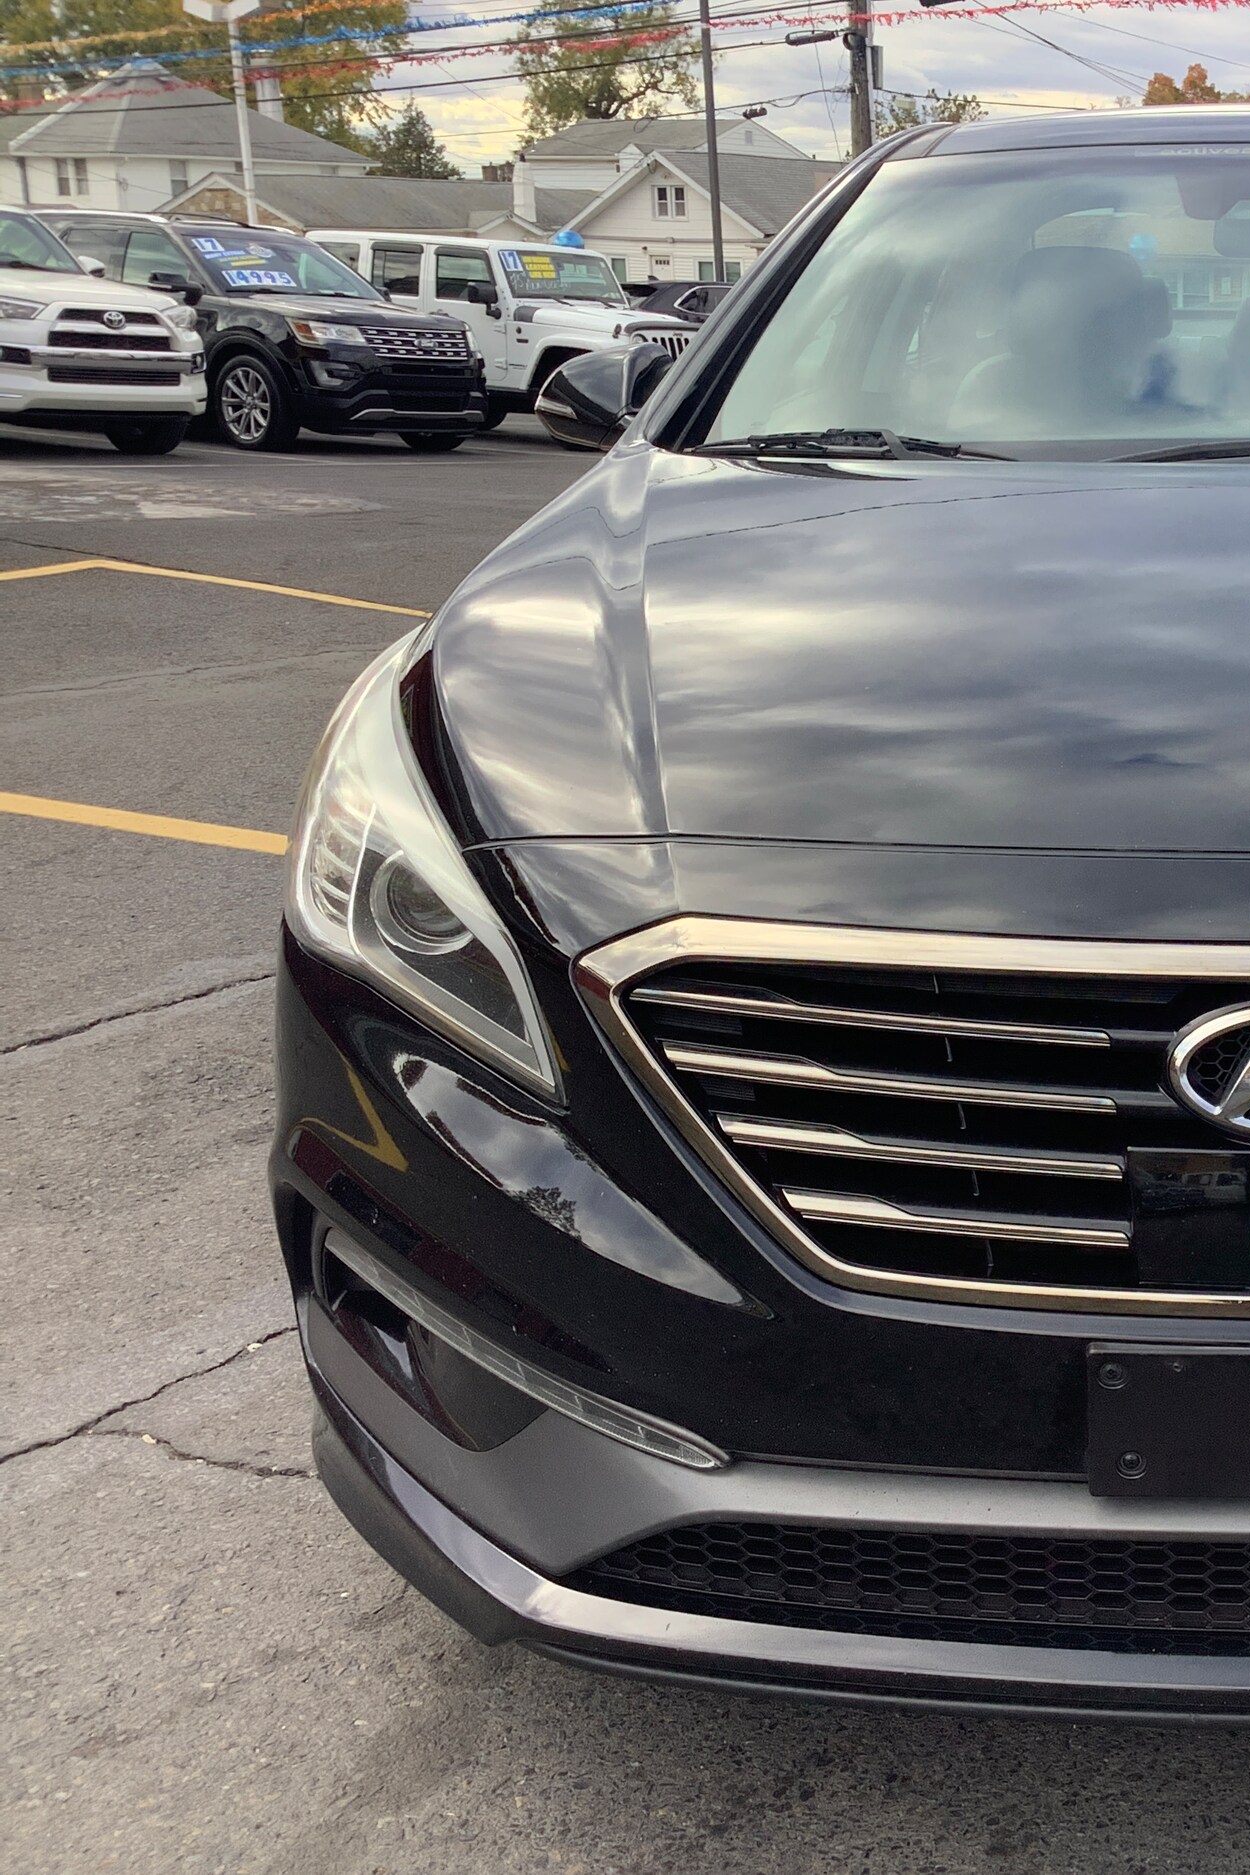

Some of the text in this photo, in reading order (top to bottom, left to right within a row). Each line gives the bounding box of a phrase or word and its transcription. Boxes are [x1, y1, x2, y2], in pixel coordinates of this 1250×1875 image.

[195, 239, 219, 251] 17
[501, 251, 518, 269] 17
[225, 271, 291, 284] 14995
